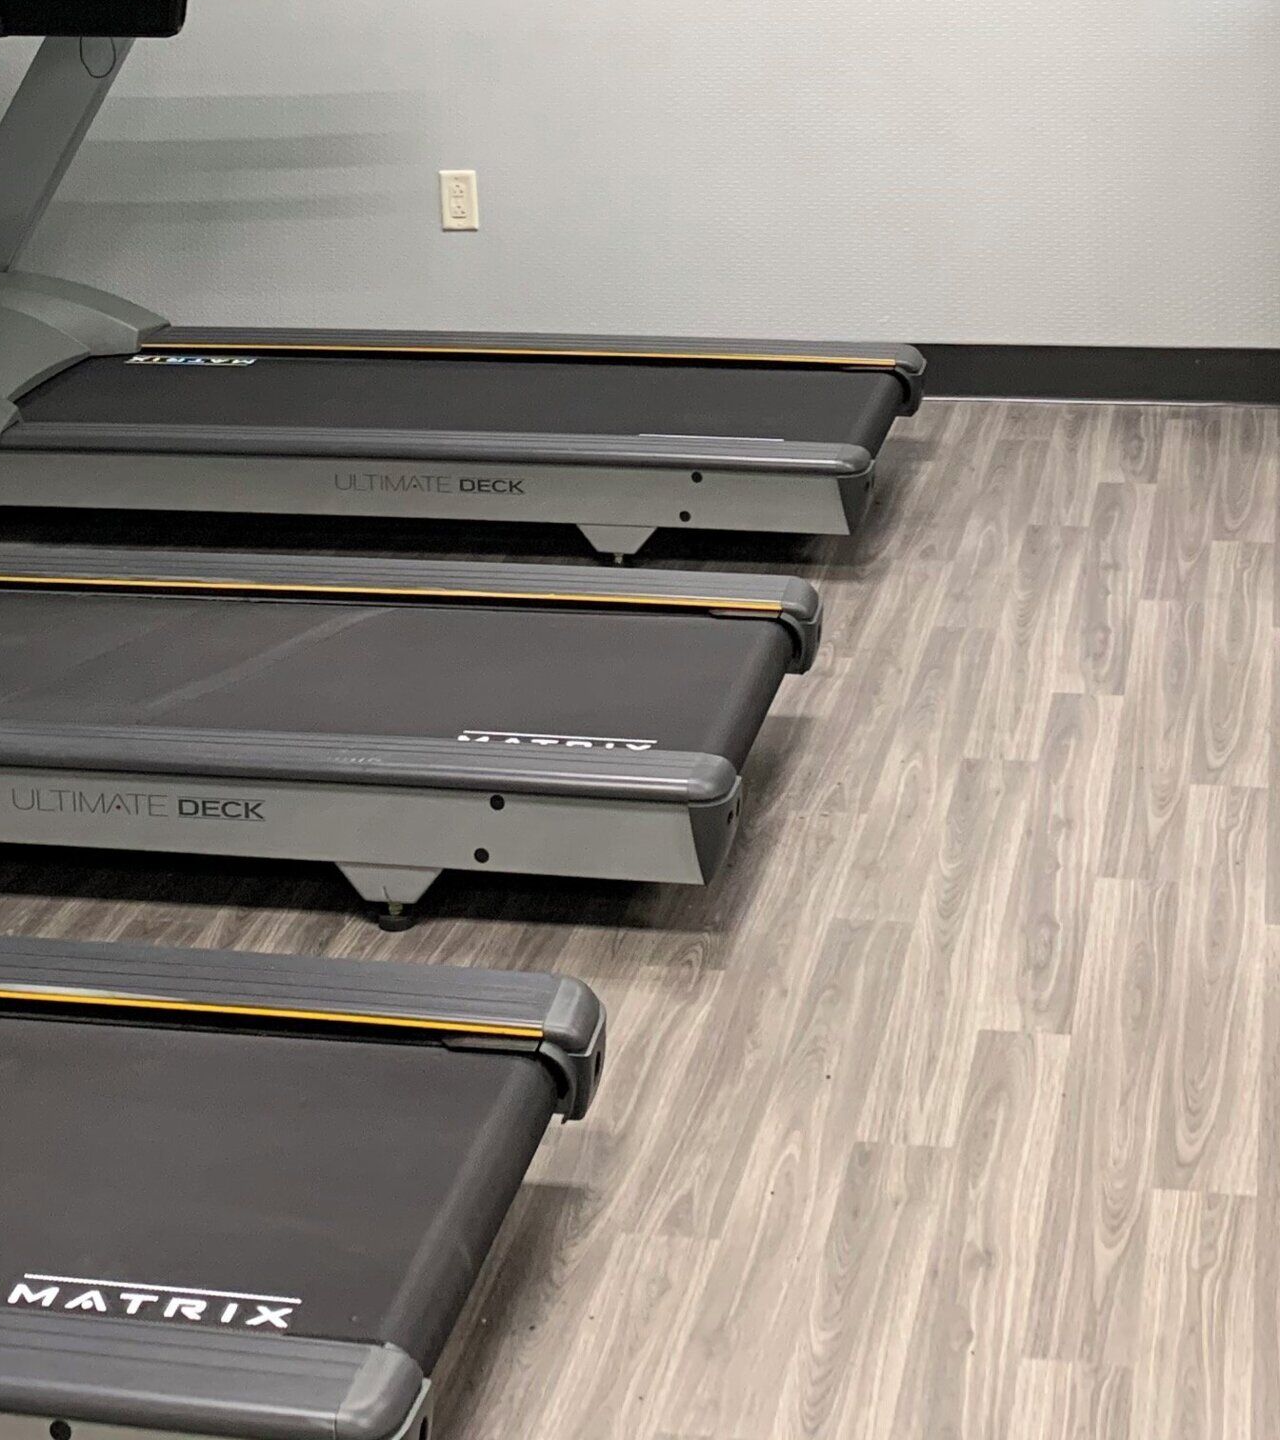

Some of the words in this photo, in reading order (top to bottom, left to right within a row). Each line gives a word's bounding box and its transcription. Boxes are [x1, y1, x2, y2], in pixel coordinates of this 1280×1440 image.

[334, 473, 452, 495] ULTIMATE
[459, 478, 526, 496] DECK
[12, 788, 169, 818] ULTIMATE
[177, 797, 265, 822] DECK
[7, 1282, 293, 1329] MATRIX
